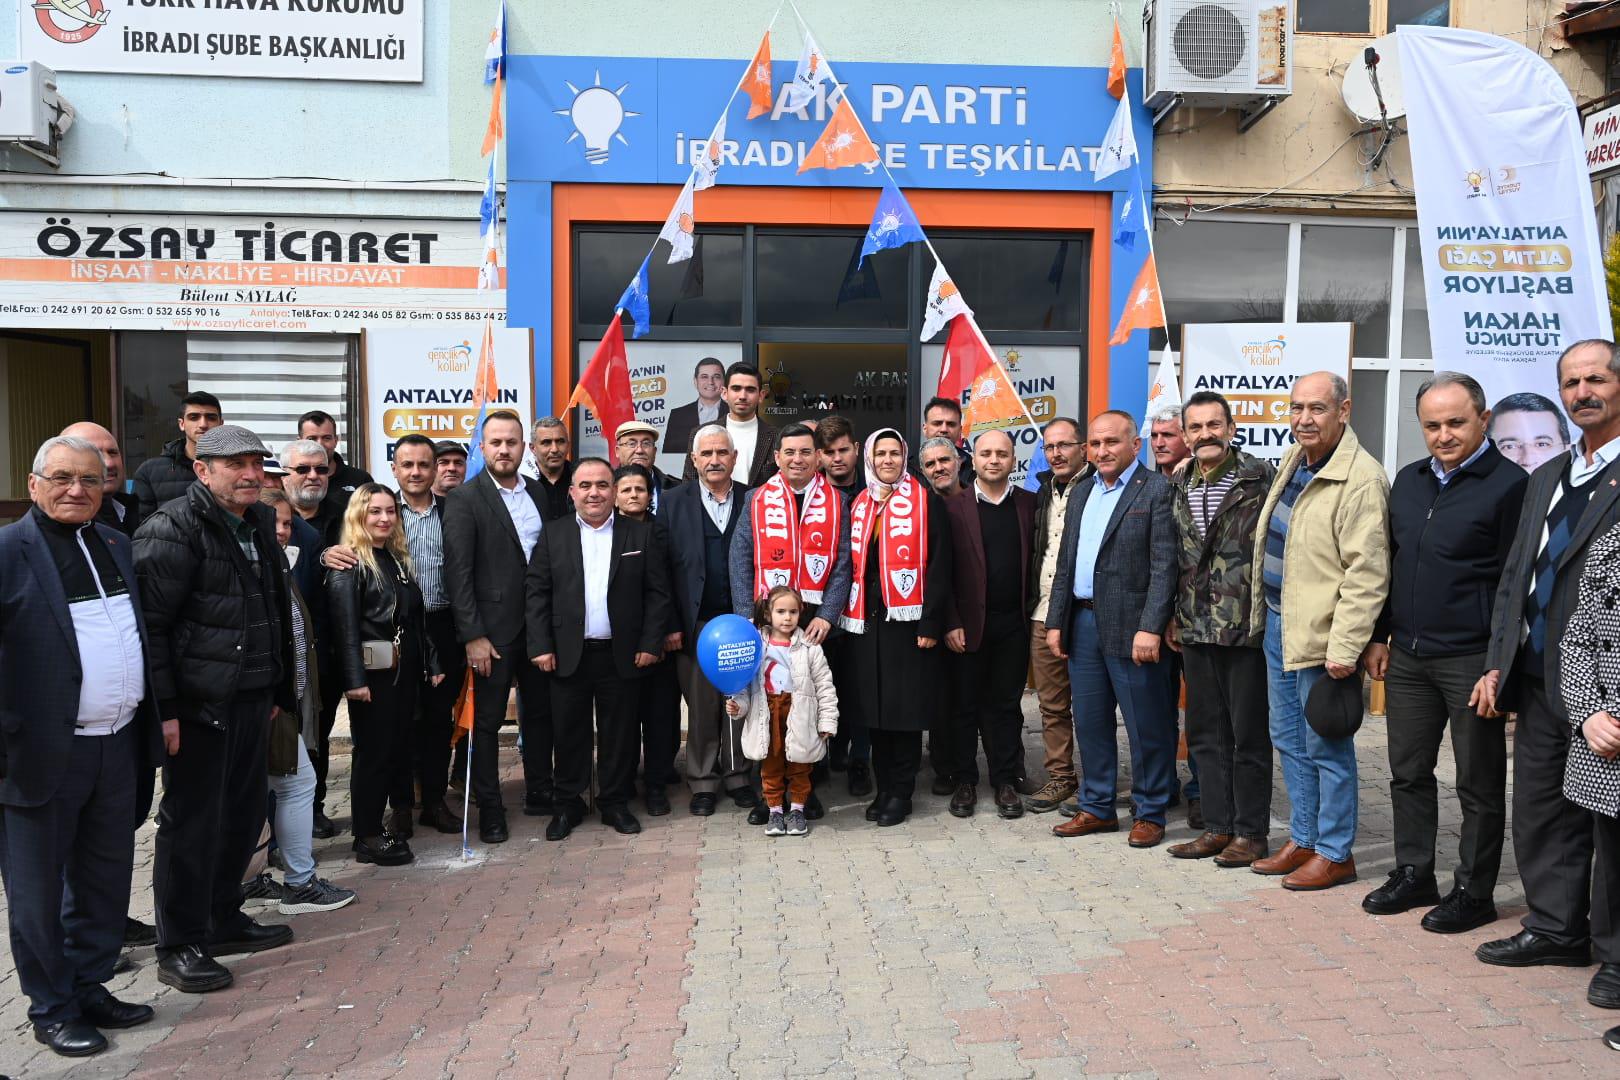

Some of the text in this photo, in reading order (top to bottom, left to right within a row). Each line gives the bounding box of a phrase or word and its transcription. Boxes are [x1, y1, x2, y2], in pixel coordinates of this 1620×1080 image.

[60, 32, 82, 42] 1925
[123, 26, 405, 64] İBRADI ŞUBE BAŞKANLIĞI
[1593, 112, 1620, 141] MİN
[676, 132, 807, 168] İBRADI
[37, 217, 438, 264] ÖZSAY TİCARET
[71, 260, 153, 282] İNŞAAT
[174, 262, 273, 282] NAKLİYE
[294, 266, 406, 284] HIRDAVAT
[179, 287, 297, 303] Bülent SAYLAĞ
[42, 305, 48, 314] 0
[51, 305, 68, 315] 242
[71, 306, 88, 315] 691
[91, 306, 103, 315] 20
[105, 306, 117, 315] 62
[119, 306, 145, 316] Gsm:
[147, 307, 154, 316] 0
[155, 307, 173, 316] 532
[175, 307, 192, 317] 655
[195, 307, 207, 317] 90
[210, 307, 221, 317] 16
[292, 309, 332, 319] Tel&Fax:
[334, 310, 341, 319] 0
[343, 310, 360, 319] 242
[362, 310, 379, 319] 346
[382, 311, 393, 320] 05
[395, 311, 407, 320] 82
[409, 312, 434, 321] Gsm:
[436, 312, 443, 320] 0
[445, 312, 462, 321] 535
[464, 312, 481, 321] 863
[484, 313, 495, 321] 44
[497, 313, 507, 321] 27
[172, 318, 307, 330] www.ozsayticaret.com
[1194, 375, 1299, 390] ANTALYA'
[384, 389, 518, 404] ANTALYAIN
[1230, 401, 1264, 416] TIN
[390, 415, 455, 432] ALTIN
